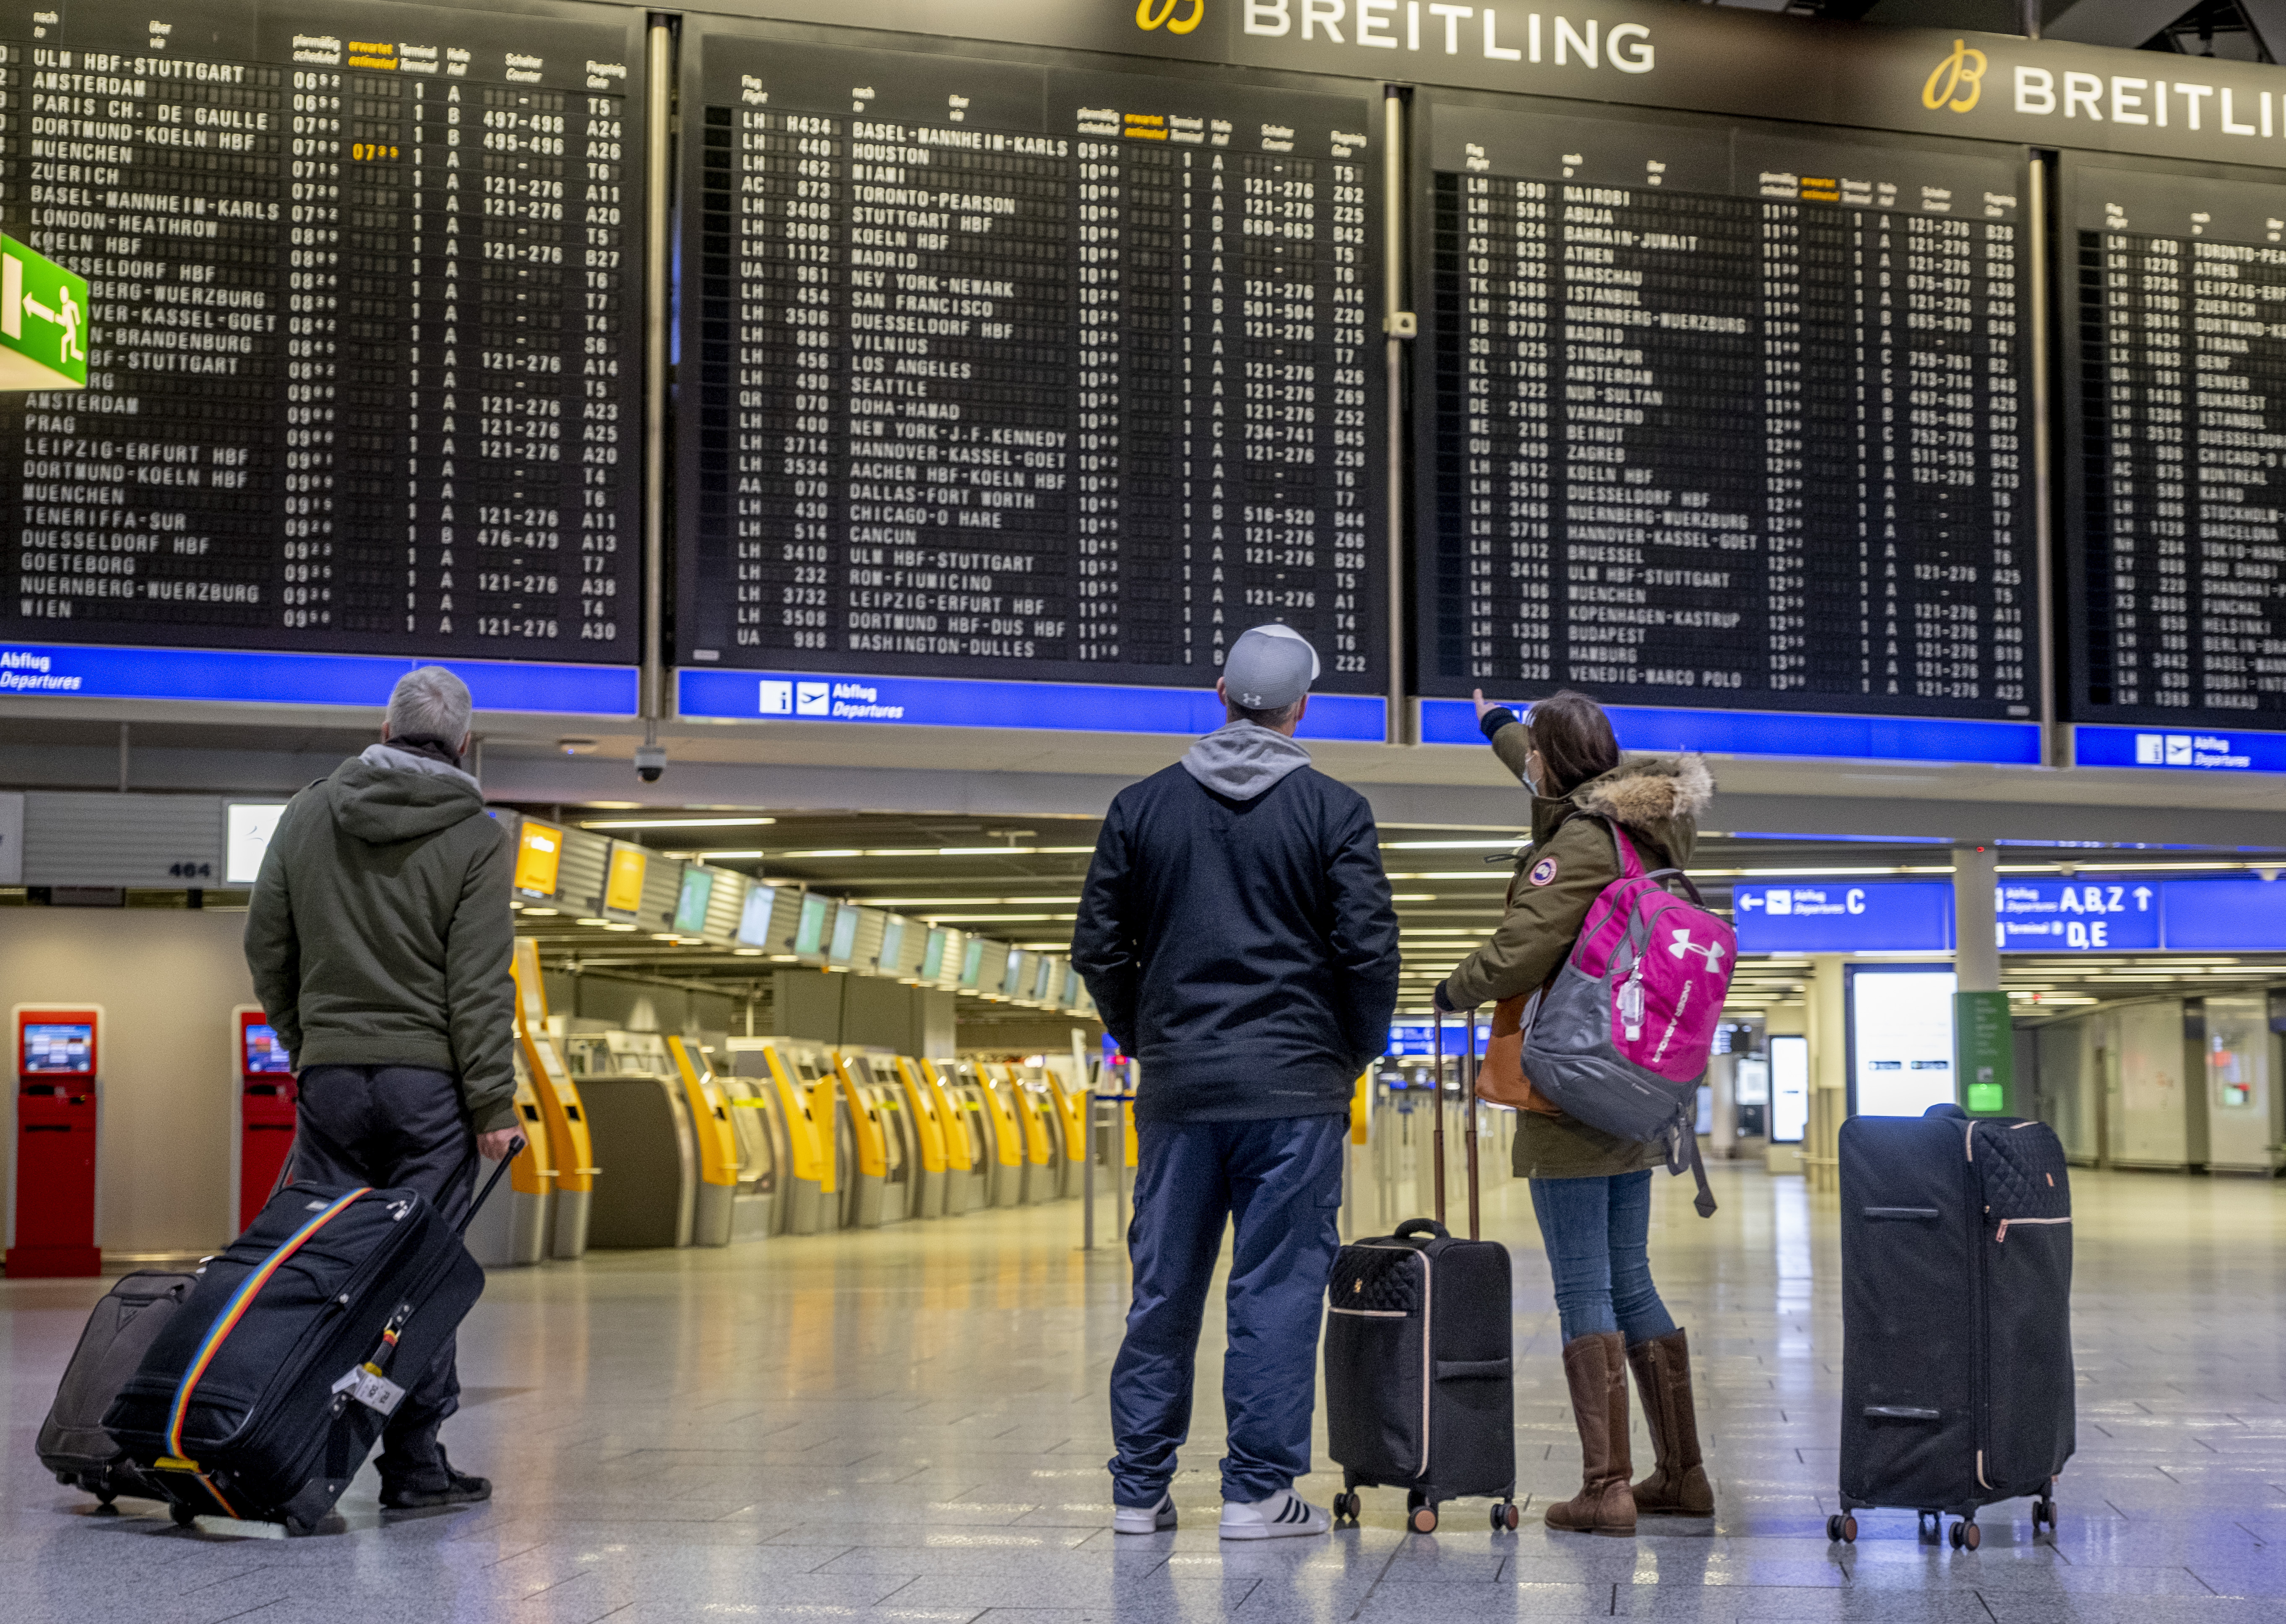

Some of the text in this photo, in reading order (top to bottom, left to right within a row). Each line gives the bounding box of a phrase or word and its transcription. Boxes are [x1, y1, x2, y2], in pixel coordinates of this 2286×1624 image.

[1243, 0, 1655, 74] BREITLING
[292, 49, 341, 65] scheduled
[348, 55, 398, 70] estimated
[398, 43, 437, 60] Terminal
[505, 53, 543, 69] Schalter
[400, 57, 439, 74] Terminal
[505, 68, 542, 83] Counter
[34, 48, 610, 117] ULM HBF-STUTTGART T5
[33, 71, 621, 138] AMSTERDAM 497-498 A24
[2015, 65, 2286, 139] BREITLI
[33, 94, 621, 160] PARIS CH. DE GAULLE 495-496 A26
[853, 121, 1067, 157] BASEL-MANNHEIM-KARLS
[32, 116, 609, 181] DORTMUND-KOELN HBF T6
[852, 143, 929, 165] HOUSTON
[31, 139, 619, 203] MUENCHEN 121-276 A11
[852, 164, 905, 183] MIAMI
[31, 162, 620, 225] ZUERICH A20
[31, 185, 279, 220] BASEL-MANNHEIM-KARLS
[853, 185, 1015, 214] TORONTO-PEARSON
[852, 206, 992, 233] STUTTGART HBF
[30, 231, 141, 255] KOELN HBF
[31, 208, 619, 268] LONDON-HEATHROW B27
[851, 227, 948, 250] KOELN HBF
[52, 255, 165, 279] ESSELDORF
[180, 264, 214, 283] HBF
[851, 248, 917, 269] MADRID
[92, 280, 264, 309] BERG-WUERZBURG
[896, 273, 1014, 297] YORK-NEWARK
[851, 291, 993, 318] SAN FRANCISCO
[91, 304, 276, 332] VER-KASSEL-GOET
[851, 312, 1013, 339] DUESSELDORF HBF
[90, 326, 618, 376] N-BRANDENBURG A14
[851, 334, 928, 355] VILNIUS
[90, 349, 237, 375] BF-STUTTGART
[852, 355, 971, 379] LOS ANGELES
[851, 376, 926, 397] SEATTLE
[25, 392, 617, 442] AMSTERDAM A25
[583, 403, 617, 420] A23
[850, 397, 960, 420] DOHA-HAMAD
[25, 414, 75, 434] PRAG
[850, 419, 884, 436] NEW
[24, 437, 247, 466] LEIPZIG-ERFURT HBF
[850, 441, 1065, 468] HANNOVER-KASSEL-GOET
[23, 460, 246, 488] DORTMUND-KOELN HBF
[850, 462, 1065, 489] AACHEN HBF-KOELN HBF
[23, 483, 124, 505] MUENCHEN
[849, 483, 1035, 508] DALLAS-FORT WORTH
[850, 504, 1001, 528] CHICAGO-O HARE
[21, 529, 208, 554] DUESSELDORF HBF
[24, 506, 186, 531] TENERIFFA-SUR
[581, 534, 616, 552] A13
[849, 526, 916, 545] CANCUN
[21, 552, 135, 575] GOETEBORG
[850, 548, 1033, 572] ULM HBF-STUTTGART
[21, 576, 259, 603] NUERNBERG-WUERZBURG
[849, 568, 992, 592] ROM-FIUMICINO
[849, 591, 1044, 615] LEIPZIG-ERFURT HBF
[21, 599, 616, 640] WIEN A30
[849, 612, 1064, 638] DORTMUND HBF-DUS HBF
[849, 633, 1034, 657] WASHINGTON-DULLES
[0, 651, 51, 673] Abflug
[0, 671, 81, 691] Departures
[832, 683, 877, 703] Abflug
[832, 701, 904, 719] Departures
[1847, 888, 1865, 914] C
[2059, 886, 2126, 915] A,B,Z
[2066, 921, 2108, 950] D,E
